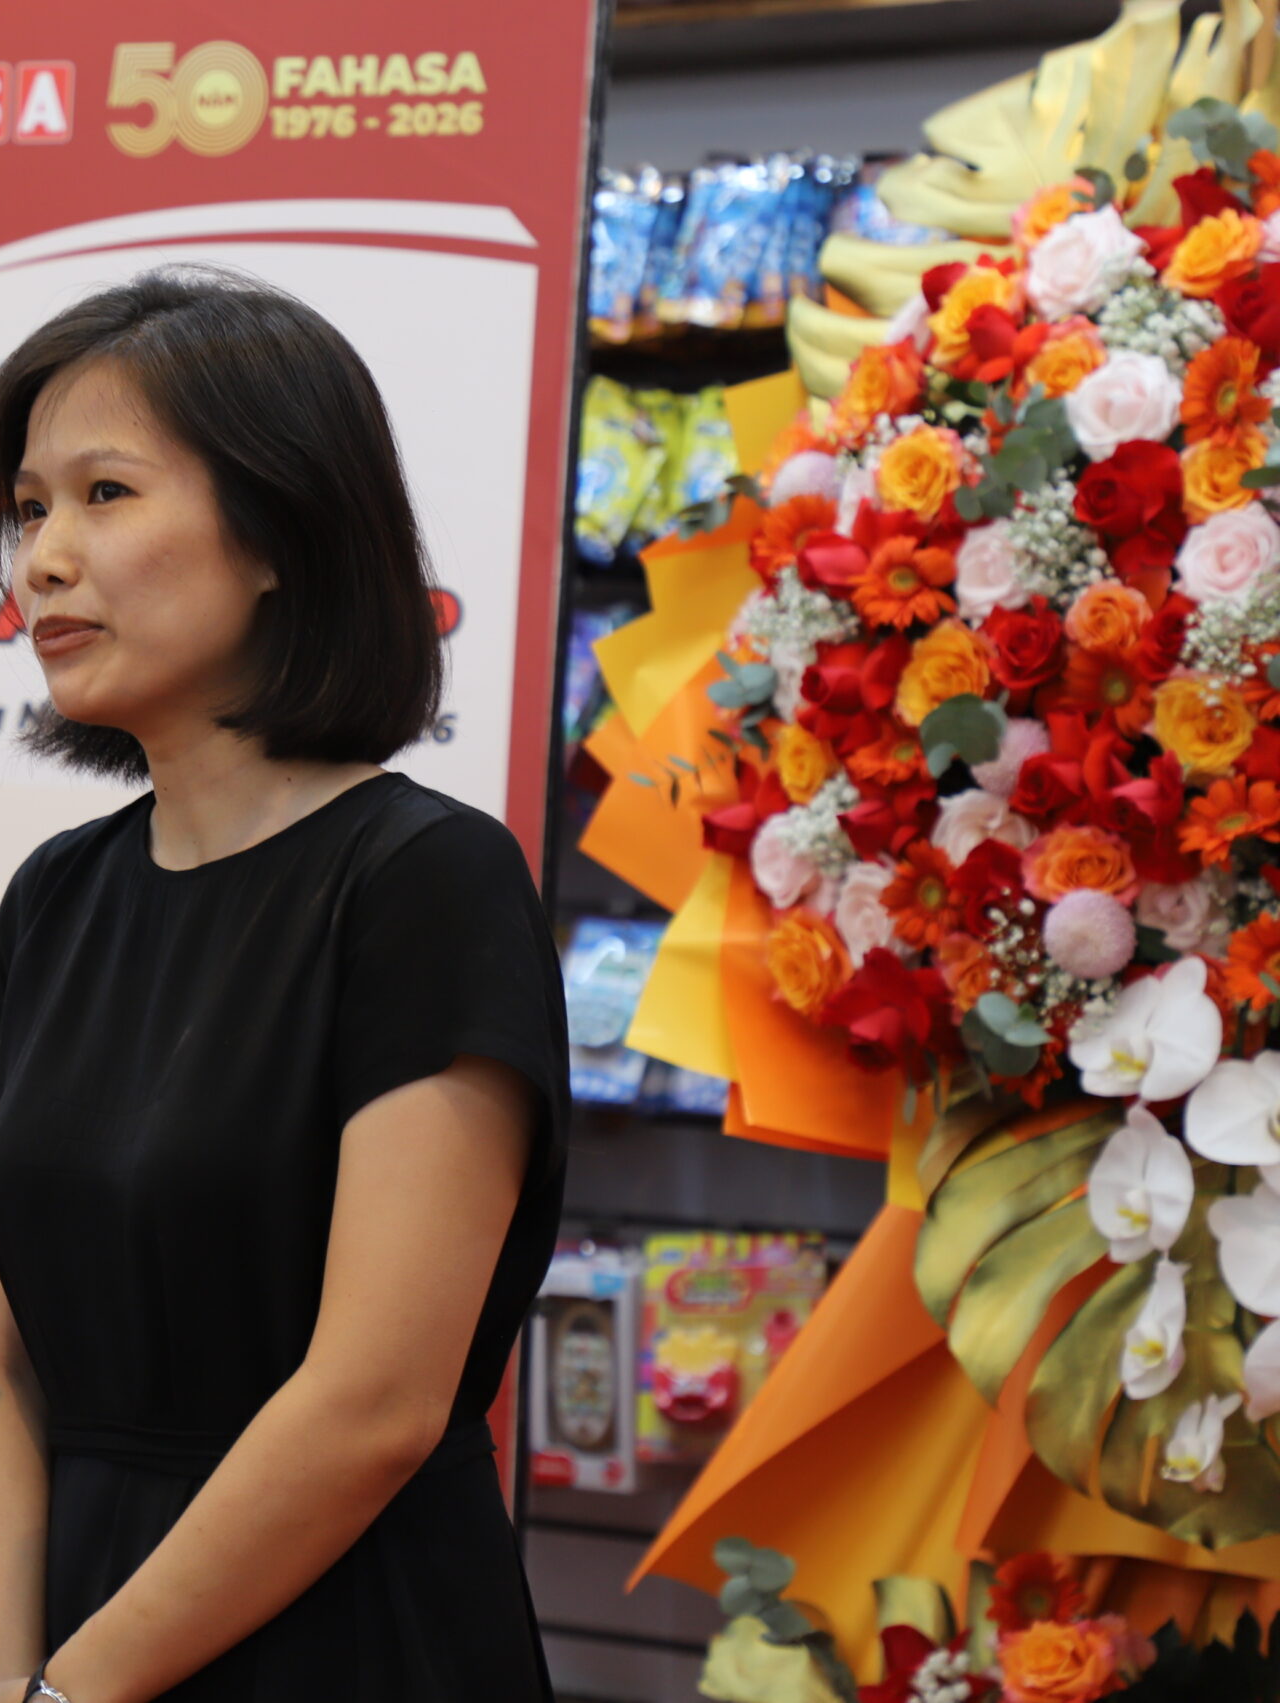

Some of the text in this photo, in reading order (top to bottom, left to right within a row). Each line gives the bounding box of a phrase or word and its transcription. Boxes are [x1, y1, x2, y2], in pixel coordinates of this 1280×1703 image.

[273, 51, 489, 99] FAHASA
[106, 40, 269, 159] 50
[271, 105, 357, 139] 1976
[387, 101, 484, 138] 2026
